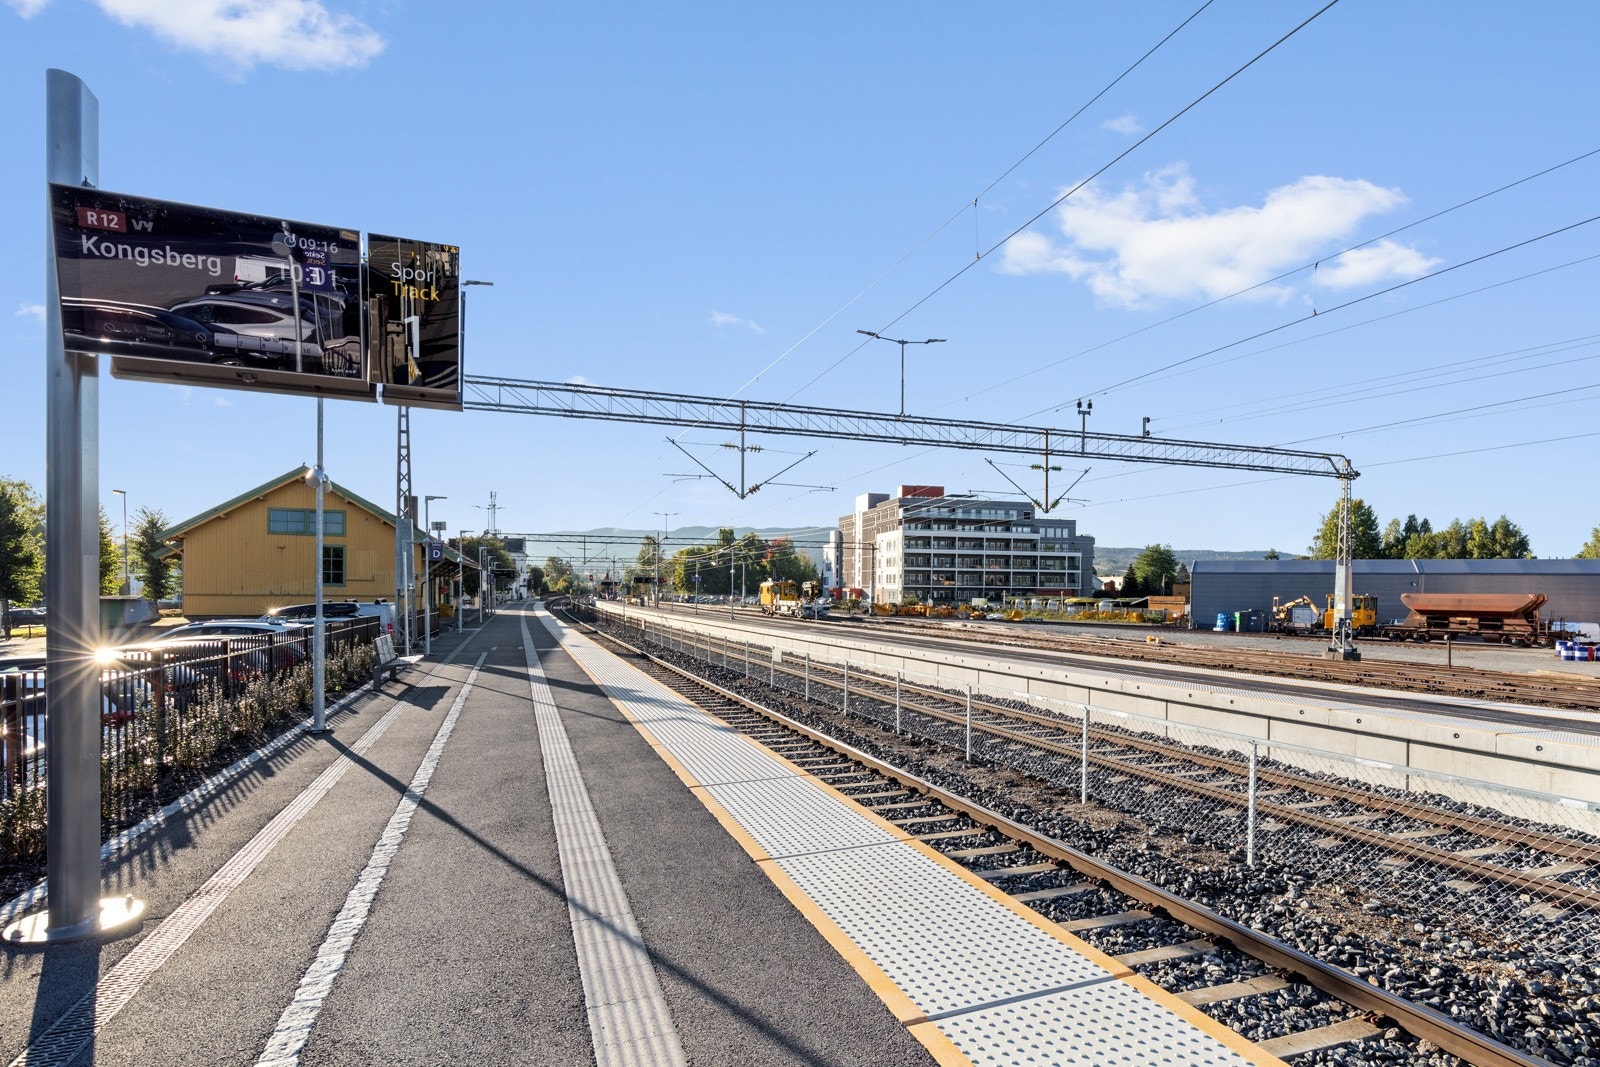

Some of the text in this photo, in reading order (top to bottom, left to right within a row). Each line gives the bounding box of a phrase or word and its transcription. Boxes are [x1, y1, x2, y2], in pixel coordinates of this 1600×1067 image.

[87, 211, 119, 229] R 12
[81, 234, 221, 277] Kongsberg
[299, 237, 338, 254] 09:16
[391, 262, 434, 283] Spor
[390, 280, 440, 302] Track
[404, 315, 420, 358] 1
[433, 549, 441, 558] D
